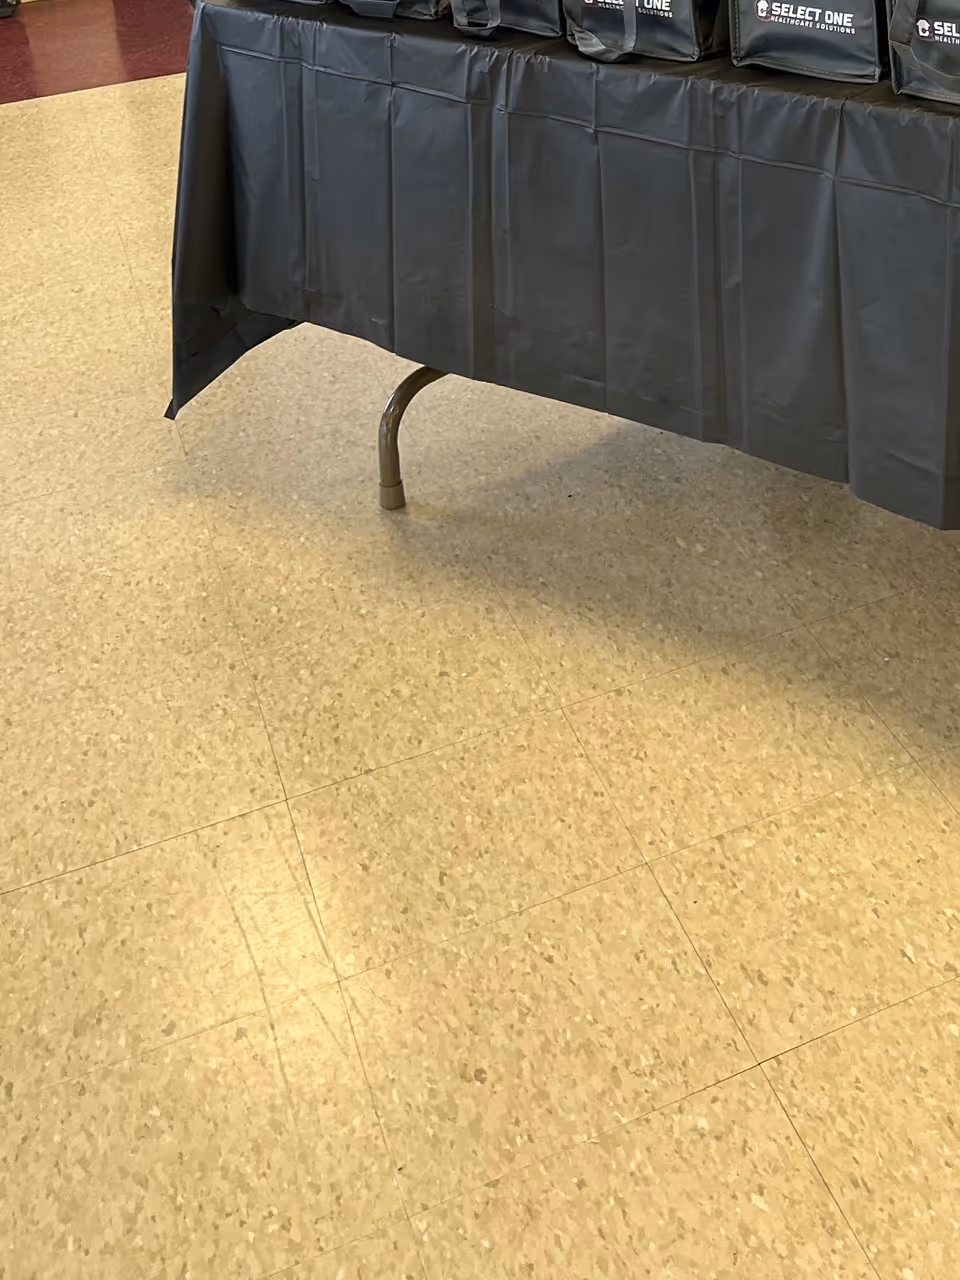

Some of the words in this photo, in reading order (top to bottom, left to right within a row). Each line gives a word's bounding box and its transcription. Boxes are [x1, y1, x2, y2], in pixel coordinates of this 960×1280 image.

[598, 2, 625, 11] HEALTHC
[638, 7, 673, 18] SOLUTIONS
[771, 2, 822, 22] SELECT
[825, 10, 854, 27] ONE
[771, 16, 813, 28] HEALTHCARE
[816, 22, 856, 35] SOLUTIONS
